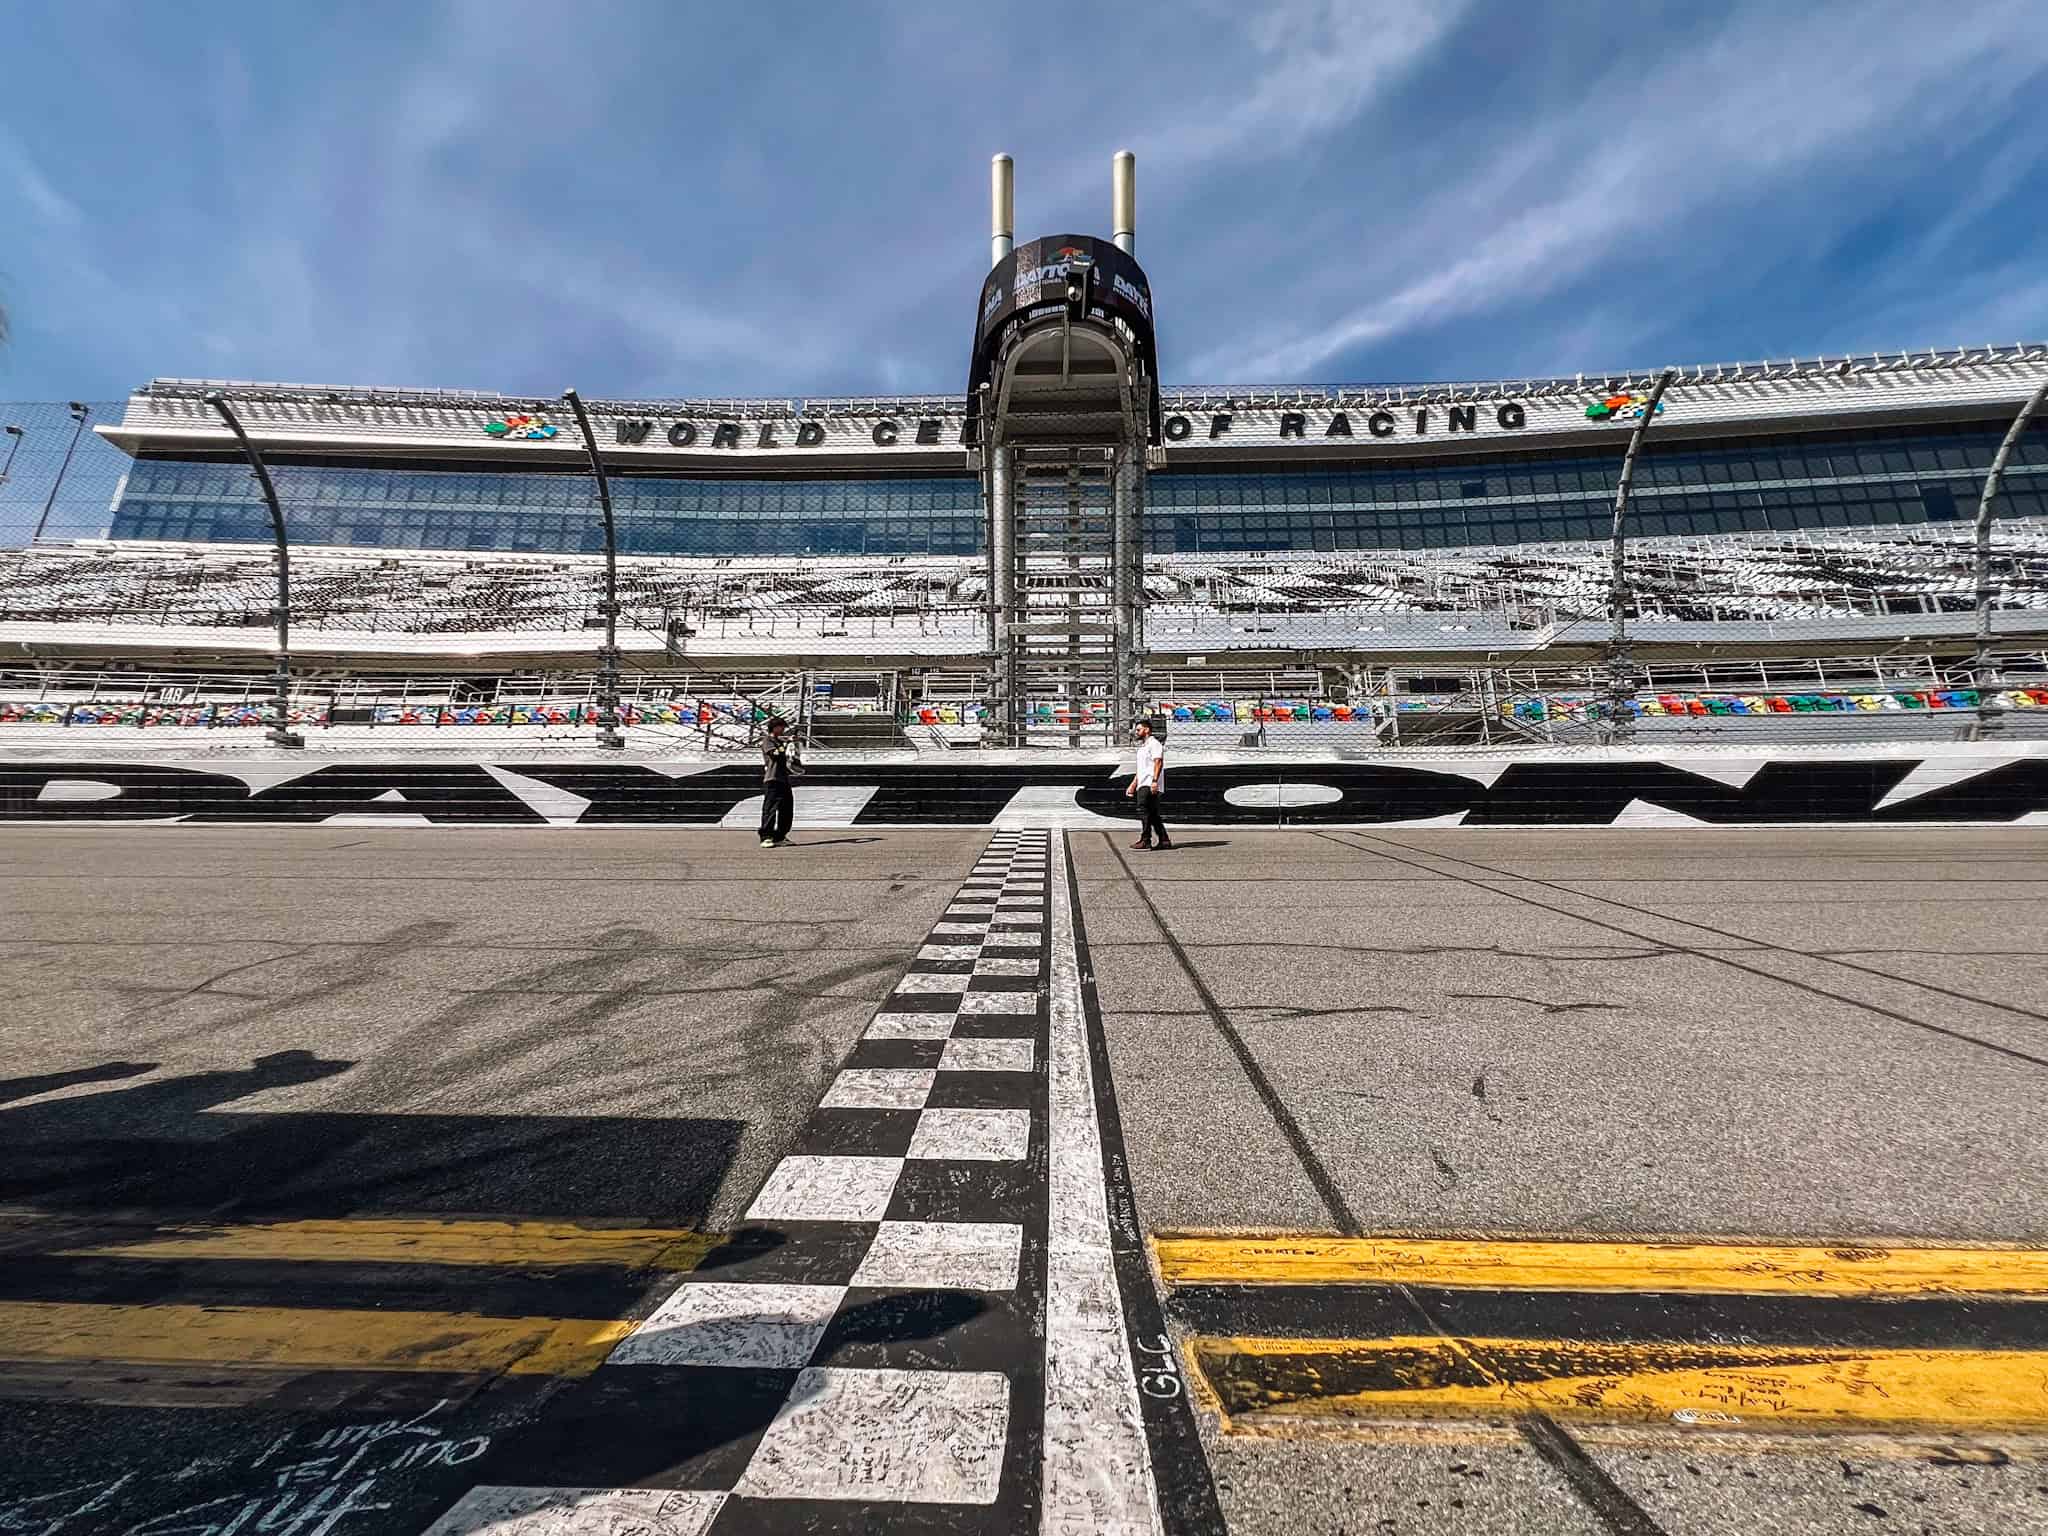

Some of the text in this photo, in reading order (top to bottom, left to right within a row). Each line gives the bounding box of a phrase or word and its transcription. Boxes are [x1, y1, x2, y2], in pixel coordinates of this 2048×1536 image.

[616, 418, 823, 448] WORLD
[1164, 414, 1233, 441] OF
[1278, 403, 1526, 437] RACING
